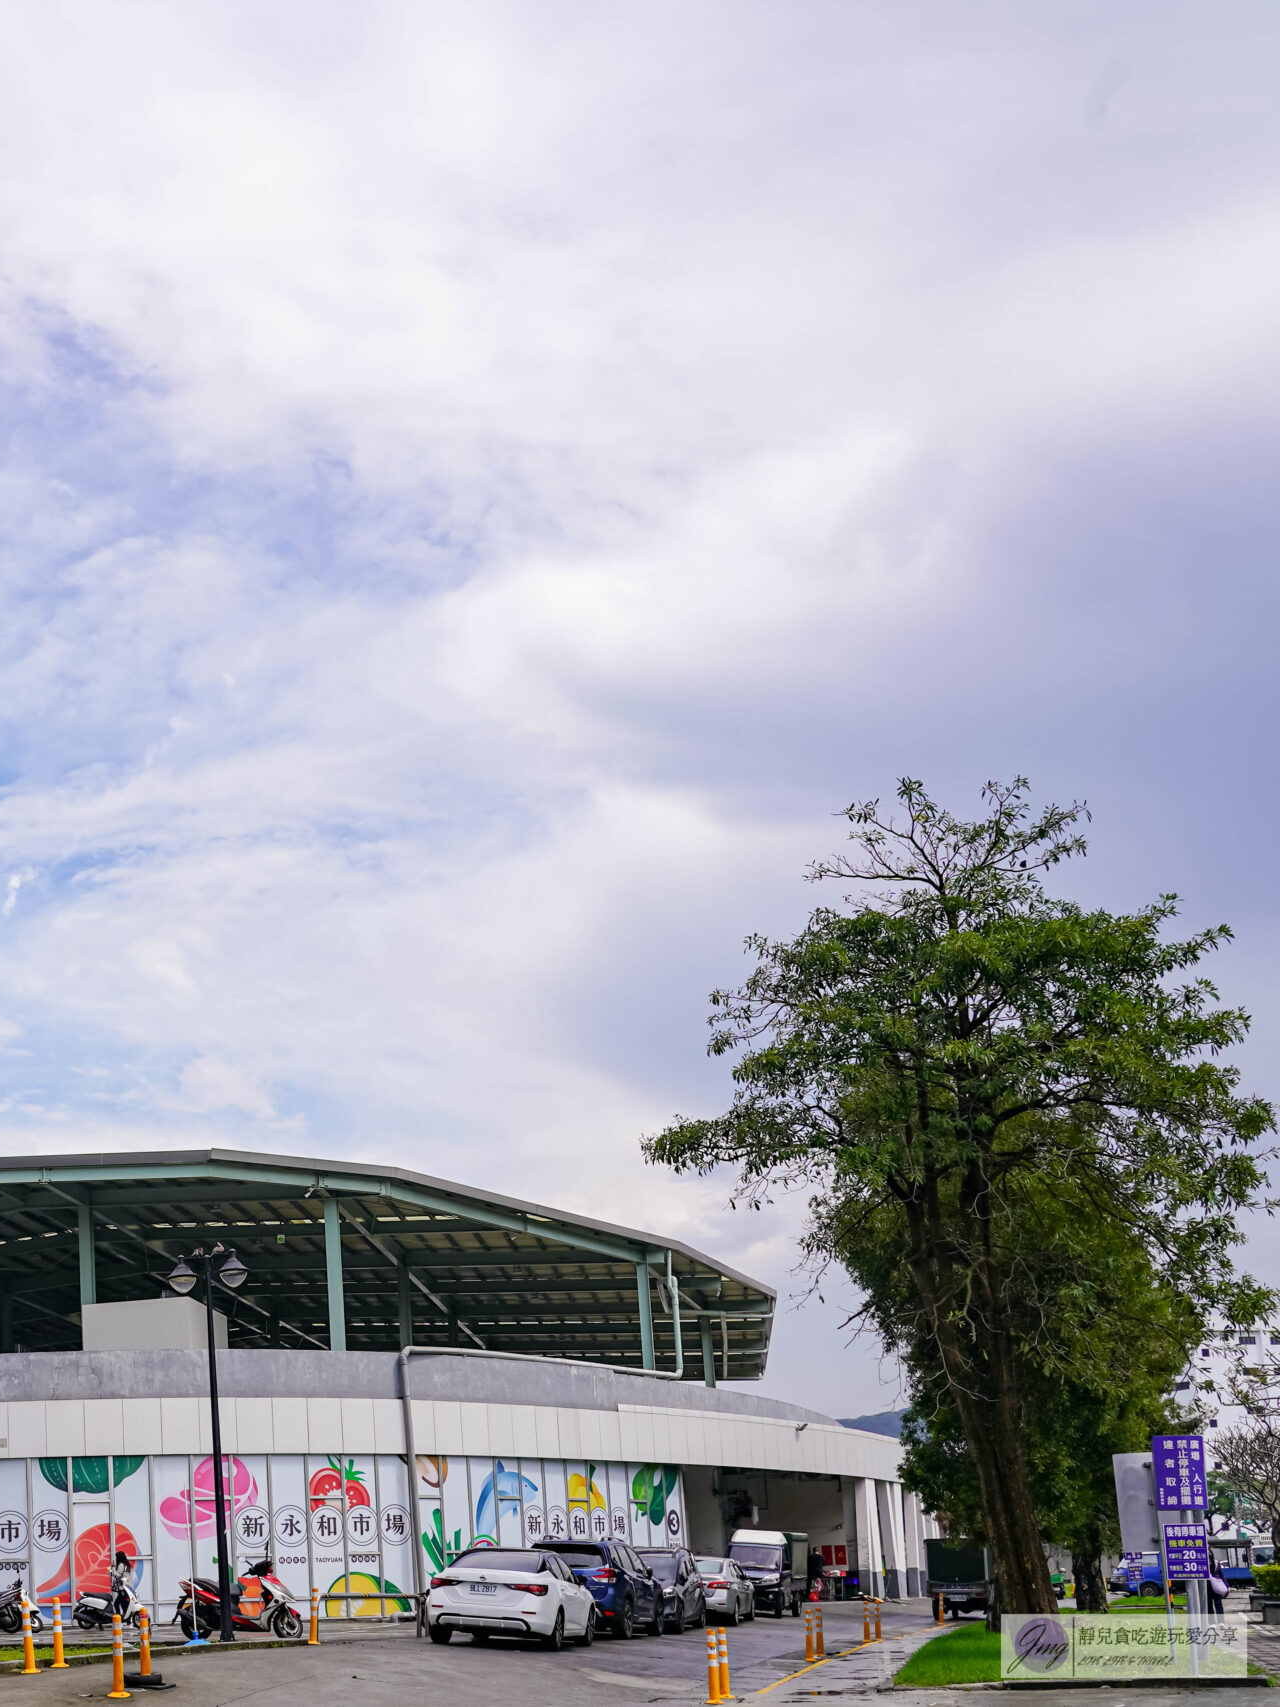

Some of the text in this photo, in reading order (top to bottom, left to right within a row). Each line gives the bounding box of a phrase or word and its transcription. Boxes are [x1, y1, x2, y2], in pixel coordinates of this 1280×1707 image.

[242, 1513, 406, 1538] 新永和市場
[527, 1515, 626, 1535] 新永和市場
[670, 1513, 678, 1531] 3
[1183, 1550, 1196, 1559] 20
[1184, 1562, 1197, 1571] 30
